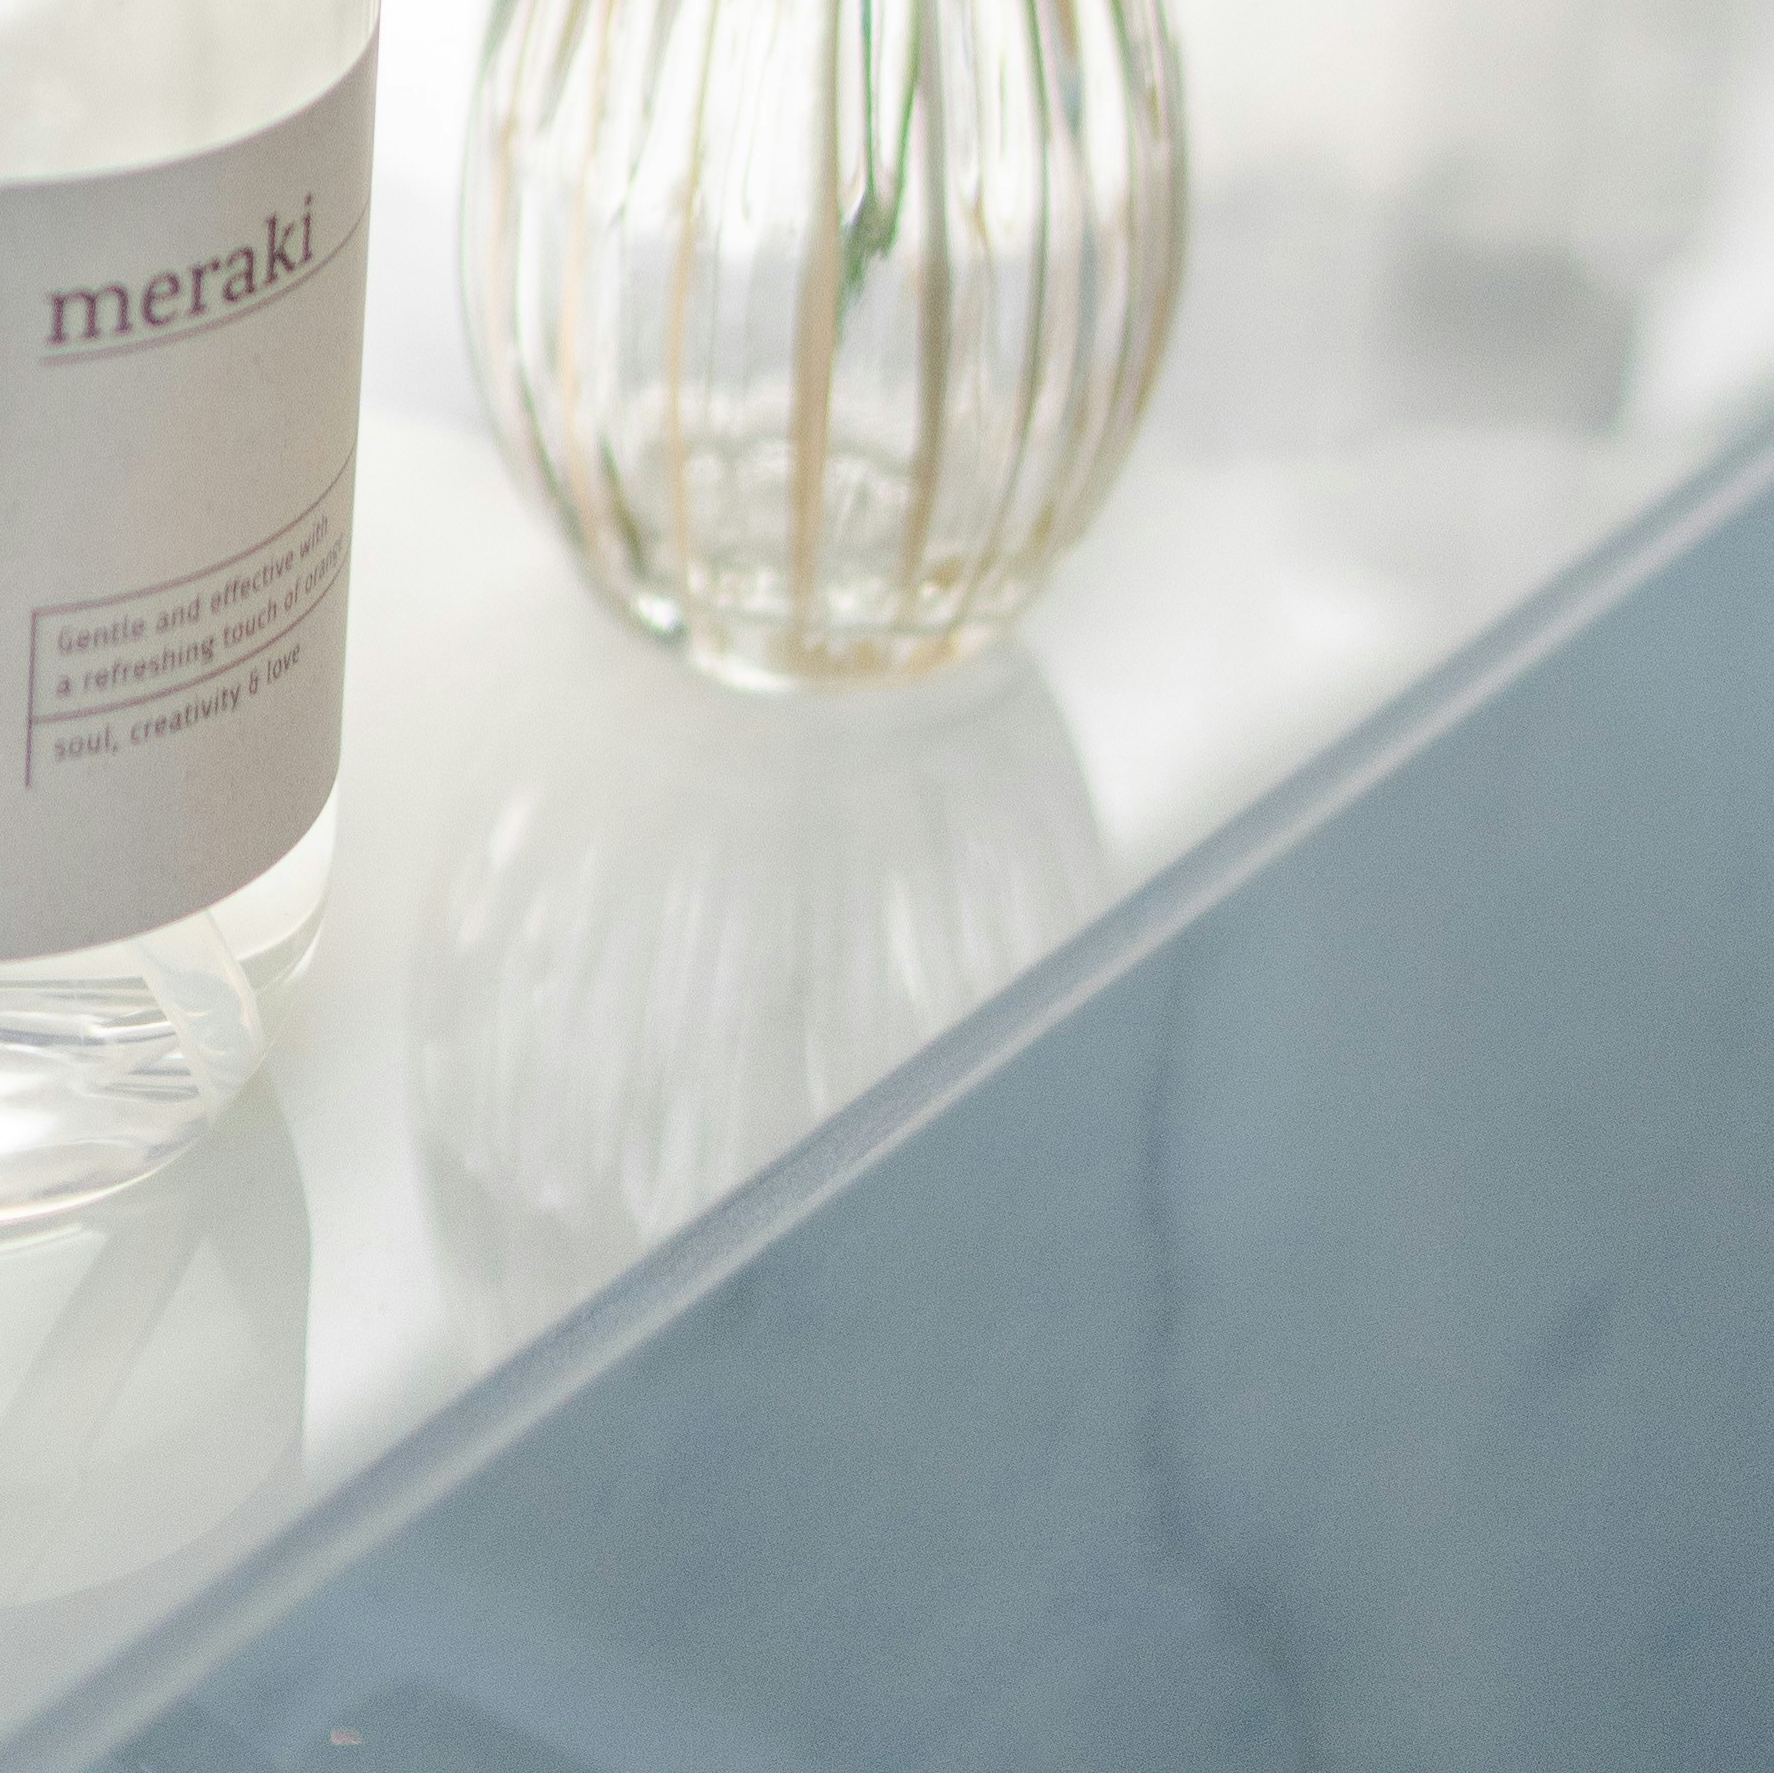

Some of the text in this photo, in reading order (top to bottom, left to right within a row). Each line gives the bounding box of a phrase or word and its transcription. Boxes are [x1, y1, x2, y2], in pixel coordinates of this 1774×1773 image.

[46, 190, 315, 345] meraki
[56, 675, 72, 697] a
[83, 634, 215, 691] refreshing
[223, 598, 277, 648] touch
[58, 615, 145, 655] Gentle
[156, 593, 201, 633] and
[210, 550, 293, 614] effective
[54, 723, 118, 761] soul,
[130, 685, 241, 744] creativity
[267, 643, 301, 684] love
